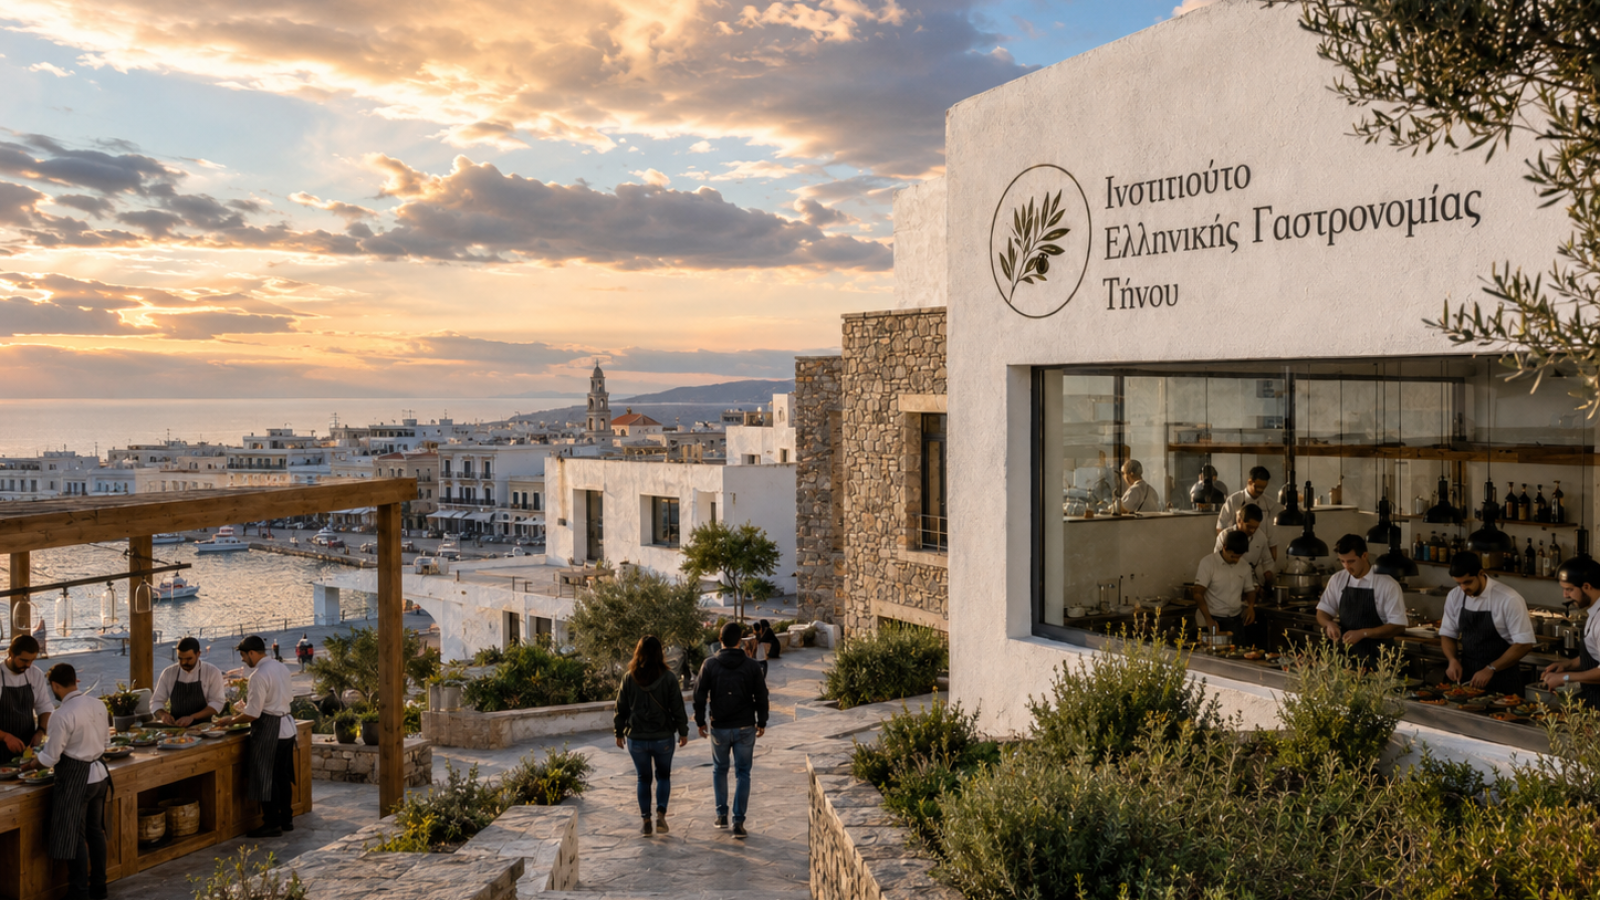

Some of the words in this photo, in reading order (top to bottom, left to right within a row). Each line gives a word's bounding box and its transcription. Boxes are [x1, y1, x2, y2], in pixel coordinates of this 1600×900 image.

[1104, 213, 1240, 261] Ελληνικής
[1252, 183, 1482, 247] Γαστρονομίας
[1102, 276, 1179, 311] Τήνου
